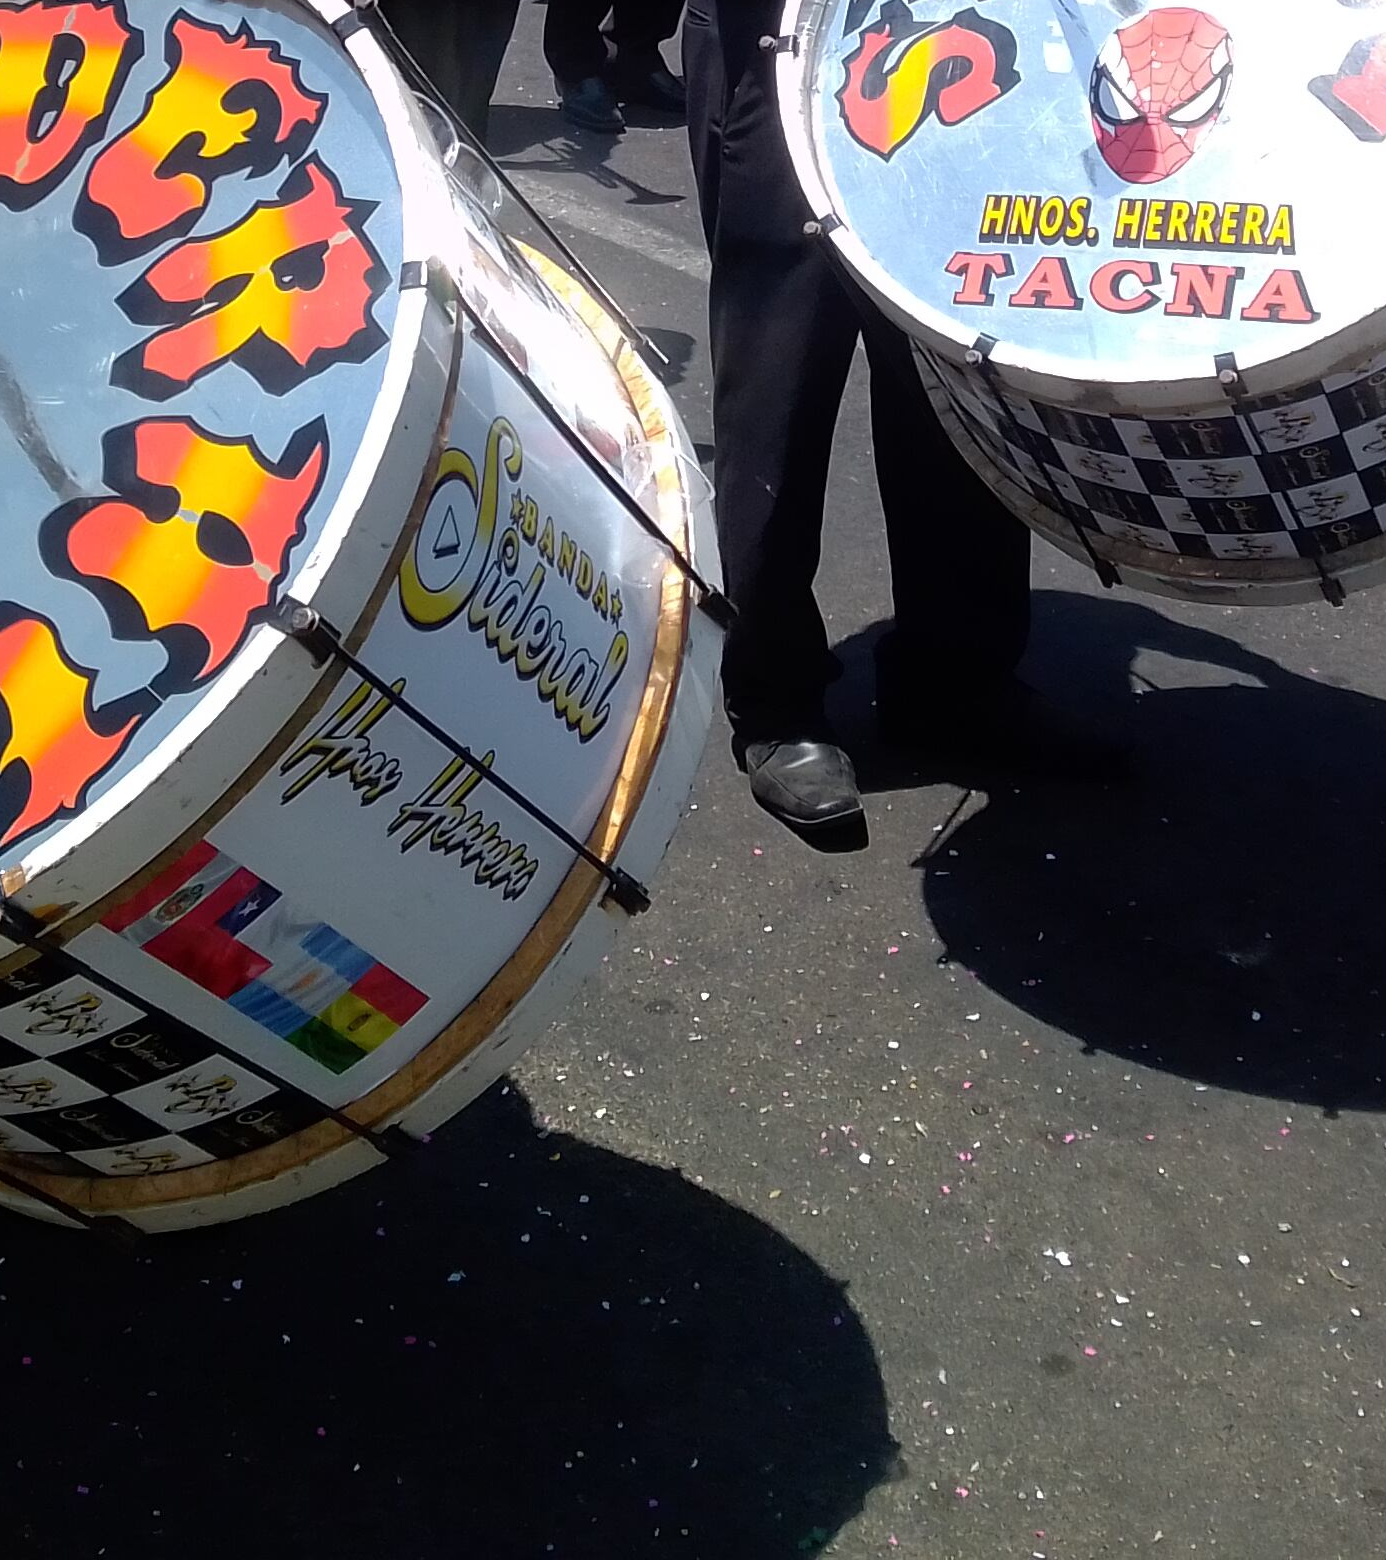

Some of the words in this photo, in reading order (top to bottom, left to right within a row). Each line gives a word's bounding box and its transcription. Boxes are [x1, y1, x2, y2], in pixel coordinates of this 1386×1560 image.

[979, 193, 1100, 247] HNOS.
[1113, 197, 1297, 255] HERRERA
[943, 249, 1323, 325] TACNA
[398, 414, 631, 744] Sideral
